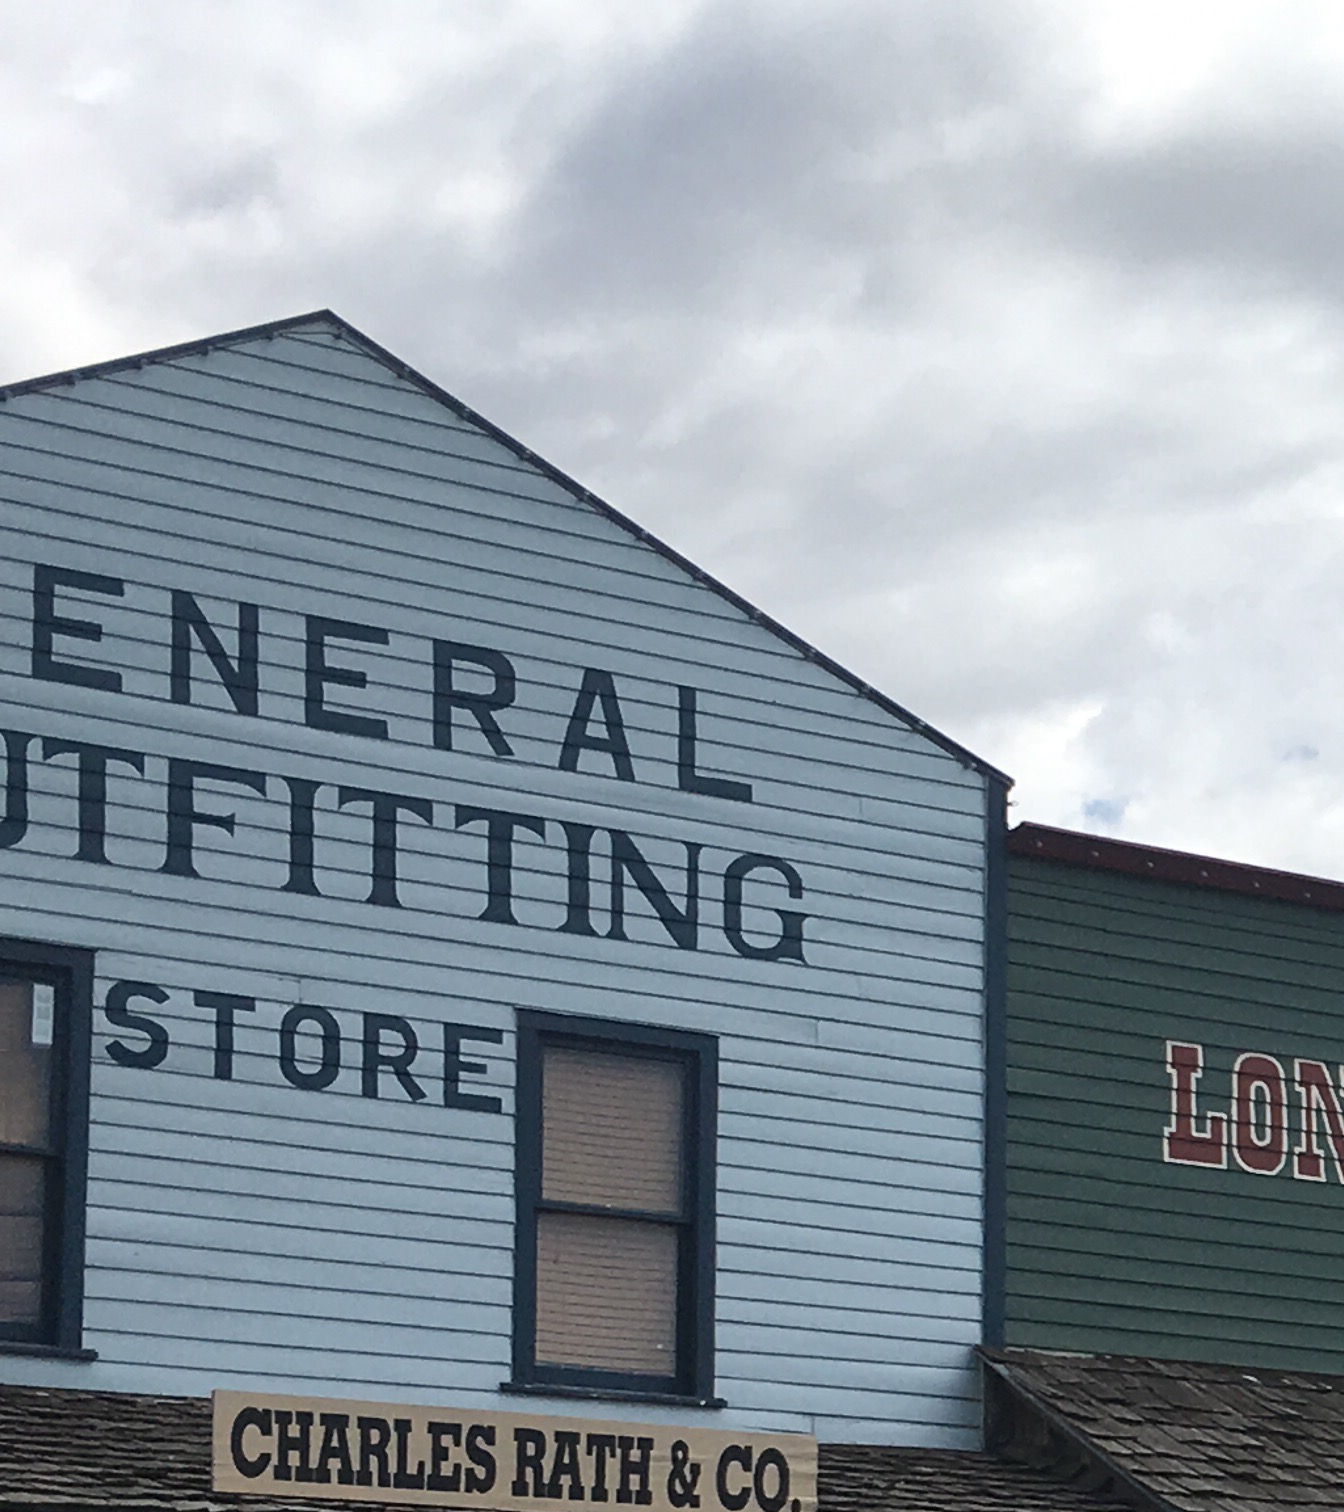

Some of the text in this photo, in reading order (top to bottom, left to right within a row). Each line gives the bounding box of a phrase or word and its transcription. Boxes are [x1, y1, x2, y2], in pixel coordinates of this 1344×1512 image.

[104, 980, 503, 1114] STORE
[231, 1407, 497, 1494] CHARLES
[511, 1427, 654, 1505] RATH
[667, 1439, 701, 1508] &
